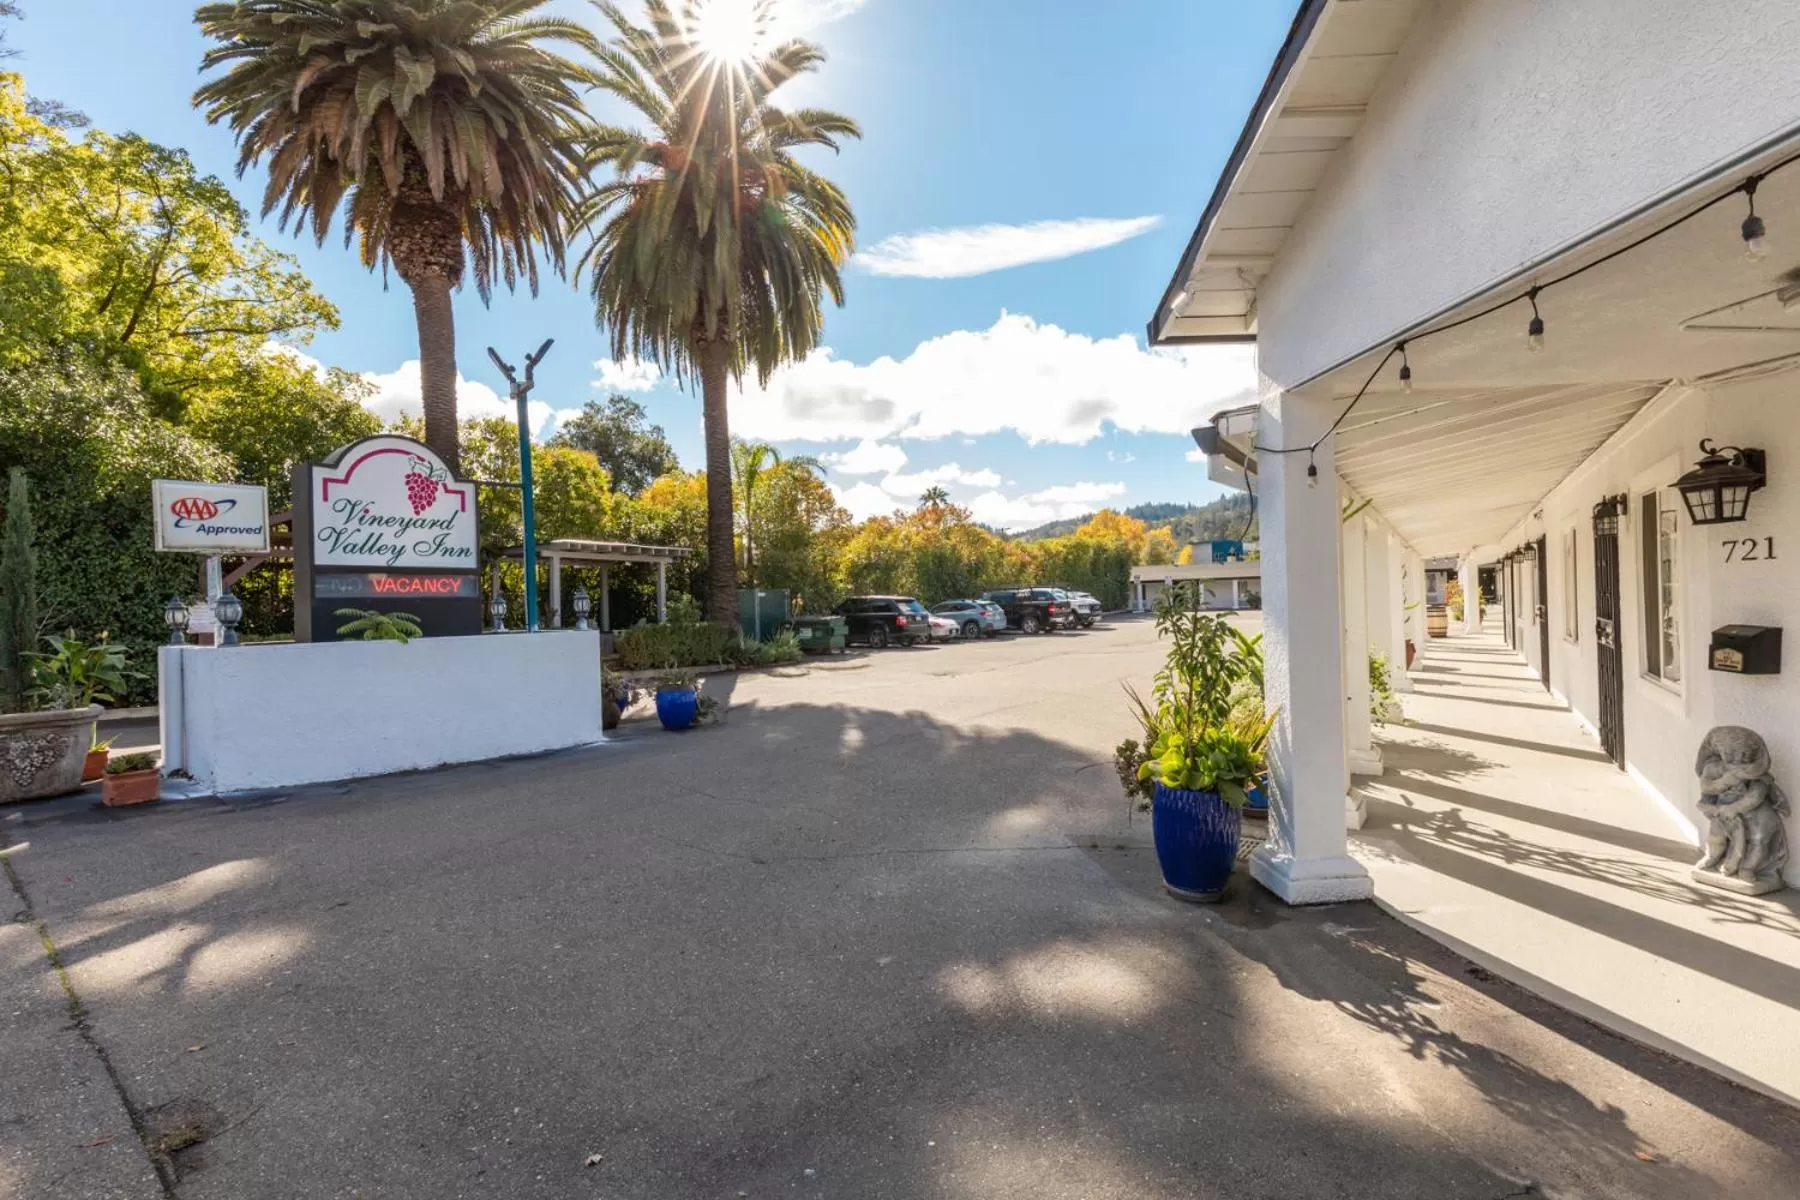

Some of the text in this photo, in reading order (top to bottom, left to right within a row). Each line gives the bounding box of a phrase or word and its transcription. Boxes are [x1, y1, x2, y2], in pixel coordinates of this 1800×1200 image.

[173, 498, 217, 520] AAA
[332, 498, 459, 538] Vineyard
[196, 523, 263, 536] Approved
[317, 526, 473, 566] Valley Inn
[1722, 536, 1777, 563] 721
[371, 576, 462, 593] VACANCY
